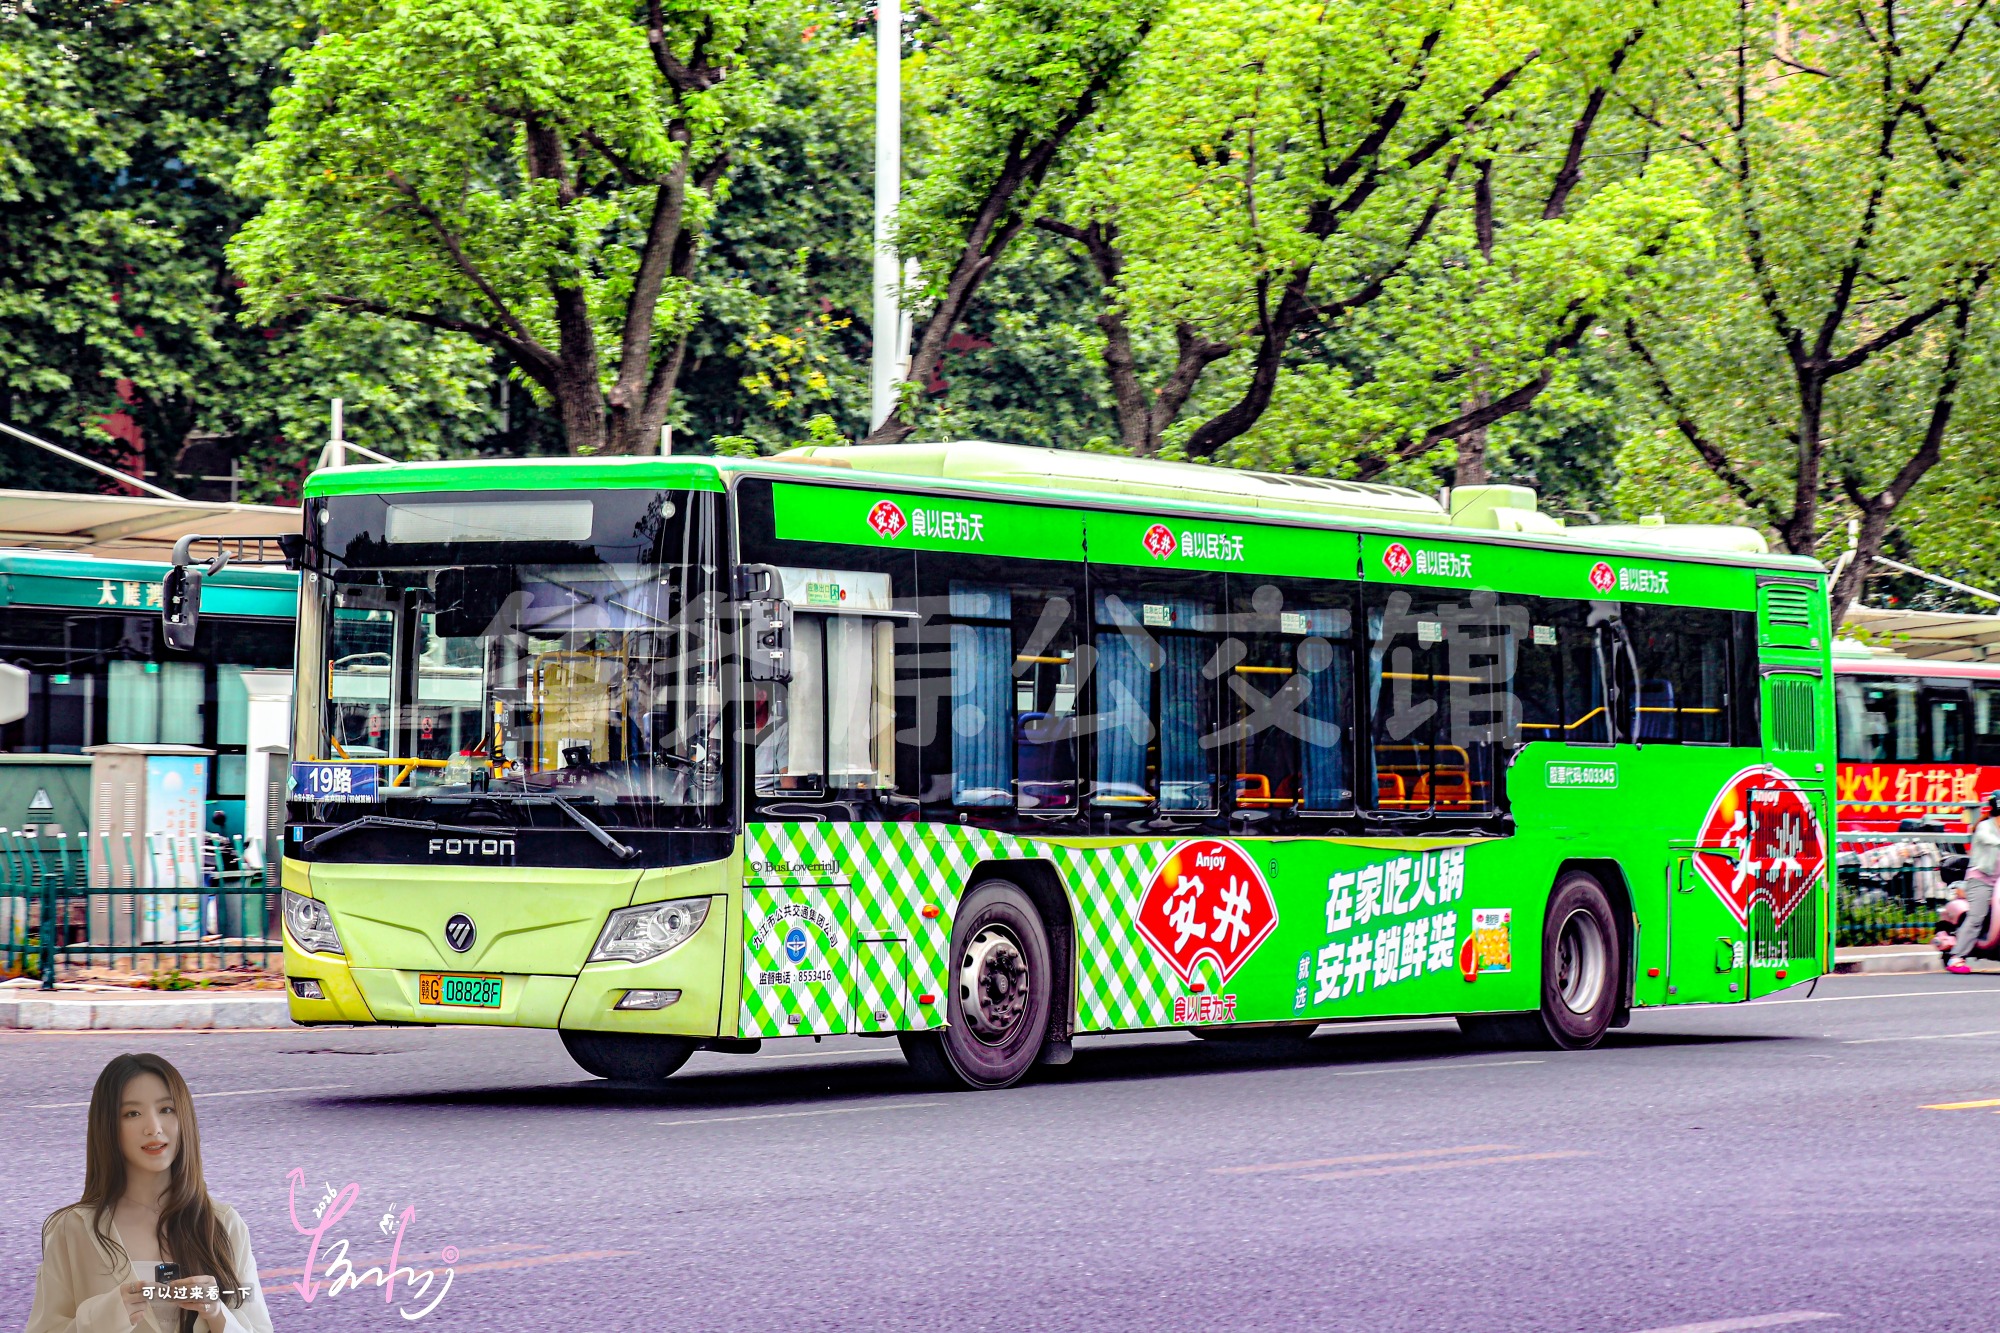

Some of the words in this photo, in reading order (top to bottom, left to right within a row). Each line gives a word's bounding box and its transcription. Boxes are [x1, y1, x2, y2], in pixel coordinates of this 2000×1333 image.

[911, 508, 984, 541] 食以民为天
[1181, 531, 1244, 561] 食以民为天
[1416, 549, 1472, 578] 食以民为天
[1619, 567, 1670, 594] 食以民为天
[309, 767, 352, 794] 19路
[429, 839, 516, 855] FOTON
[1195, 849, 1226, 871] Anjoy
[1326, 847, 1465, 933] 在家吃火锅
[753, 903, 838, 949] 九江市公共交通集团公司
[1162, 874, 1251, 955] 安井
[1313, 911, 1457, 1005] 安井锁鲜装
[1174, 994, 1237, 1022] 食以民为天
